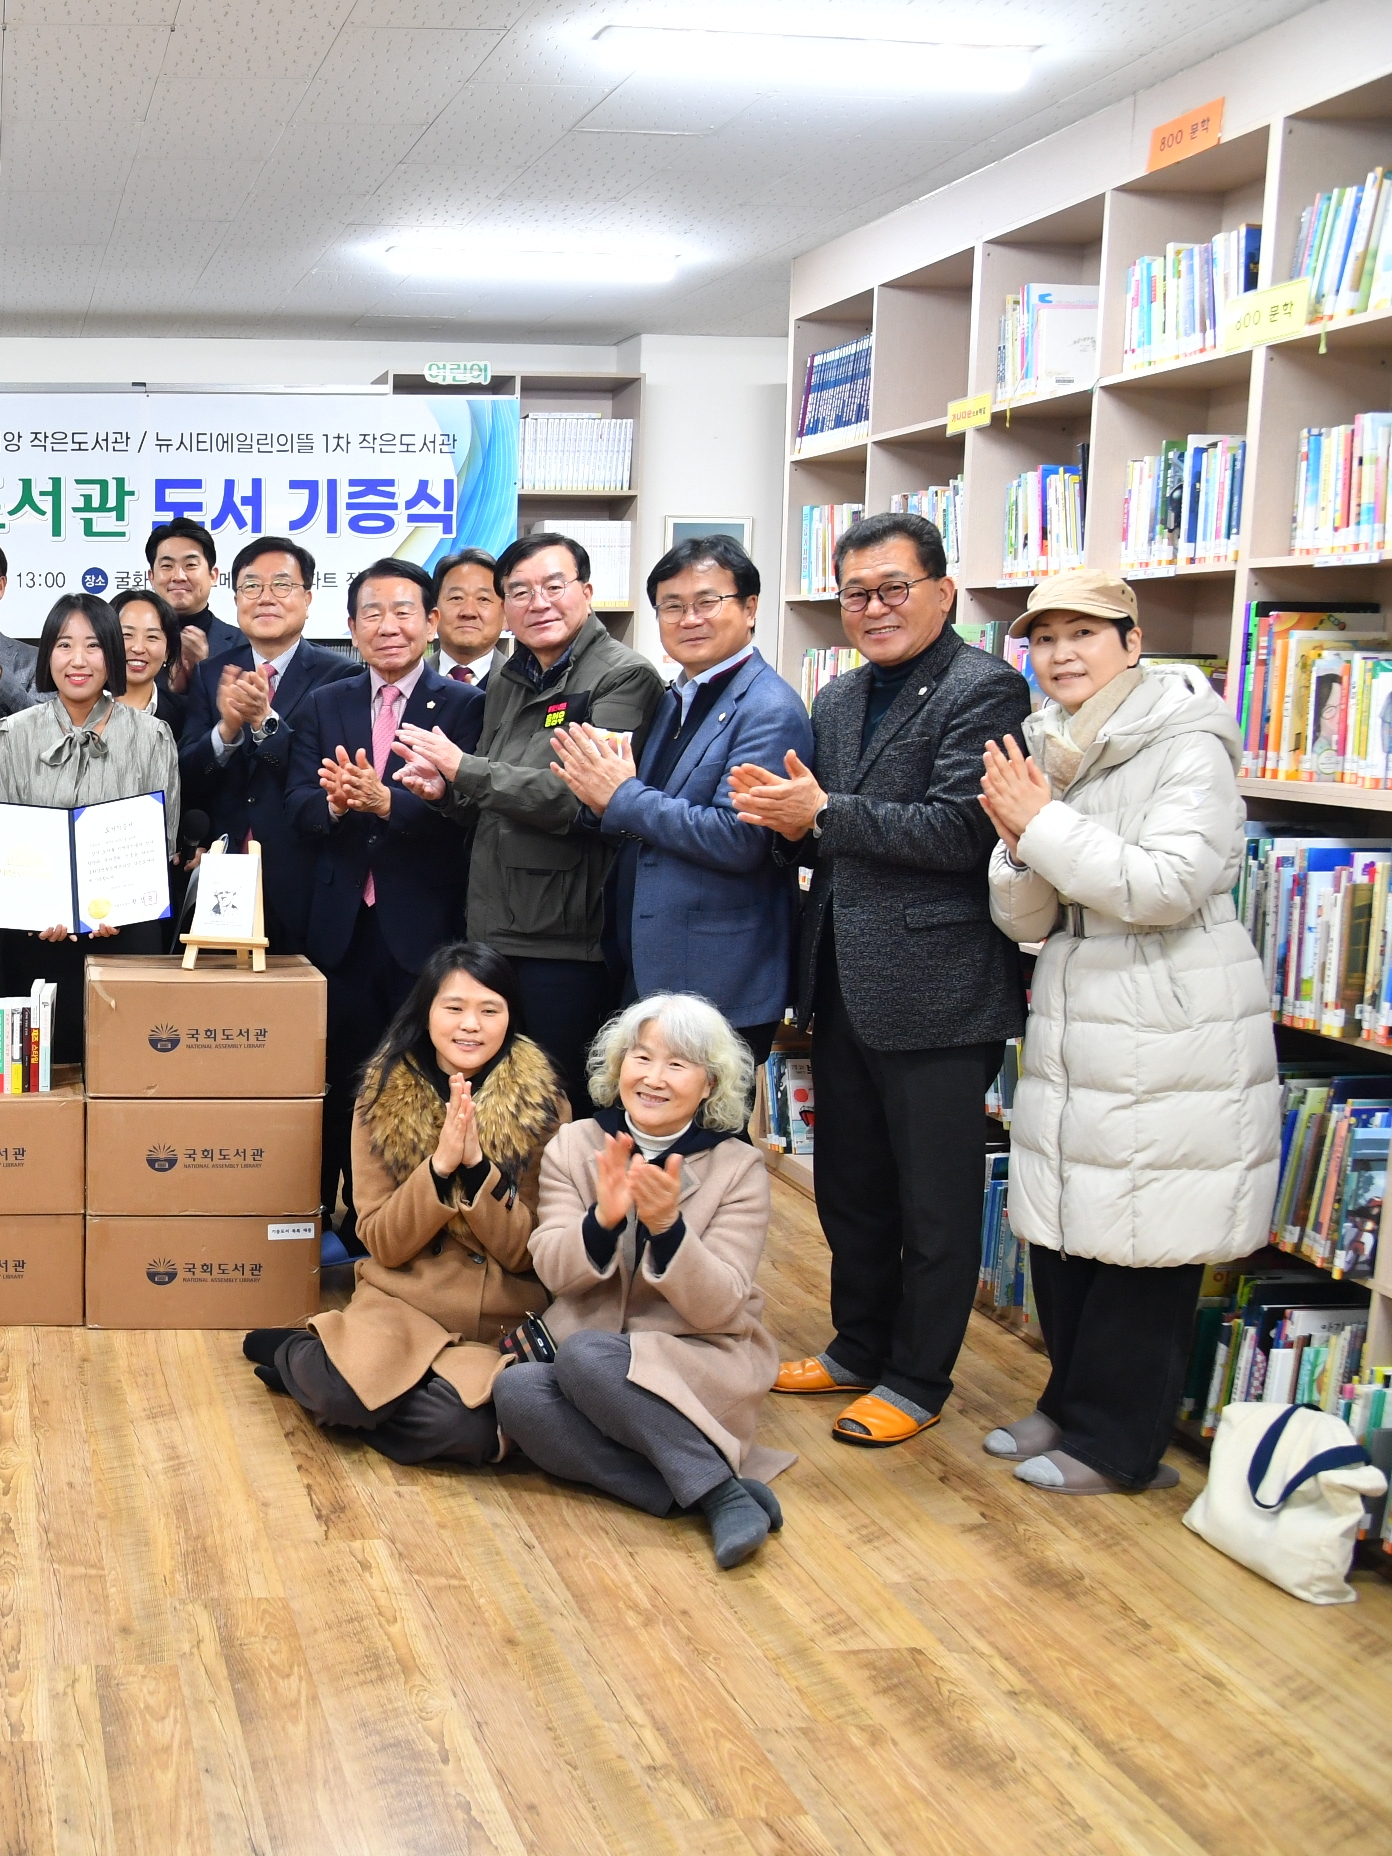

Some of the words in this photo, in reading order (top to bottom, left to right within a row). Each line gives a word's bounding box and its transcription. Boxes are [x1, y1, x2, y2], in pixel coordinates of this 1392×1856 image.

[1160, 129, 1184, 152] 800
[1189, 116, 1211, 140] 문학
[1269, 300, 1294, 323] 문학
[428, 362, 488, 383] 어린이
[29, 430, 132, 453] 작은도서관
[137, 430, 148, 454] /
[154, 431, 314, 454] 뉴시티에일린의뜰
[321, 432, 352, 455] 1차
[358, 432, 458, 455] 작은도서관
[151, 477, 263, 537] 도서
[288, 477, 456, 538] 기증식
[16, 571, 66, 589] 13:00
[84, 574, 106, 588] 장소
[186, 1028, 268, 1042] 국회도서관
[31, 1044, 39, 1064] 스타일
[183, 1148, 265, 1162] 국회도서관
[183, 1263, 263, 1277] 국회도서관
